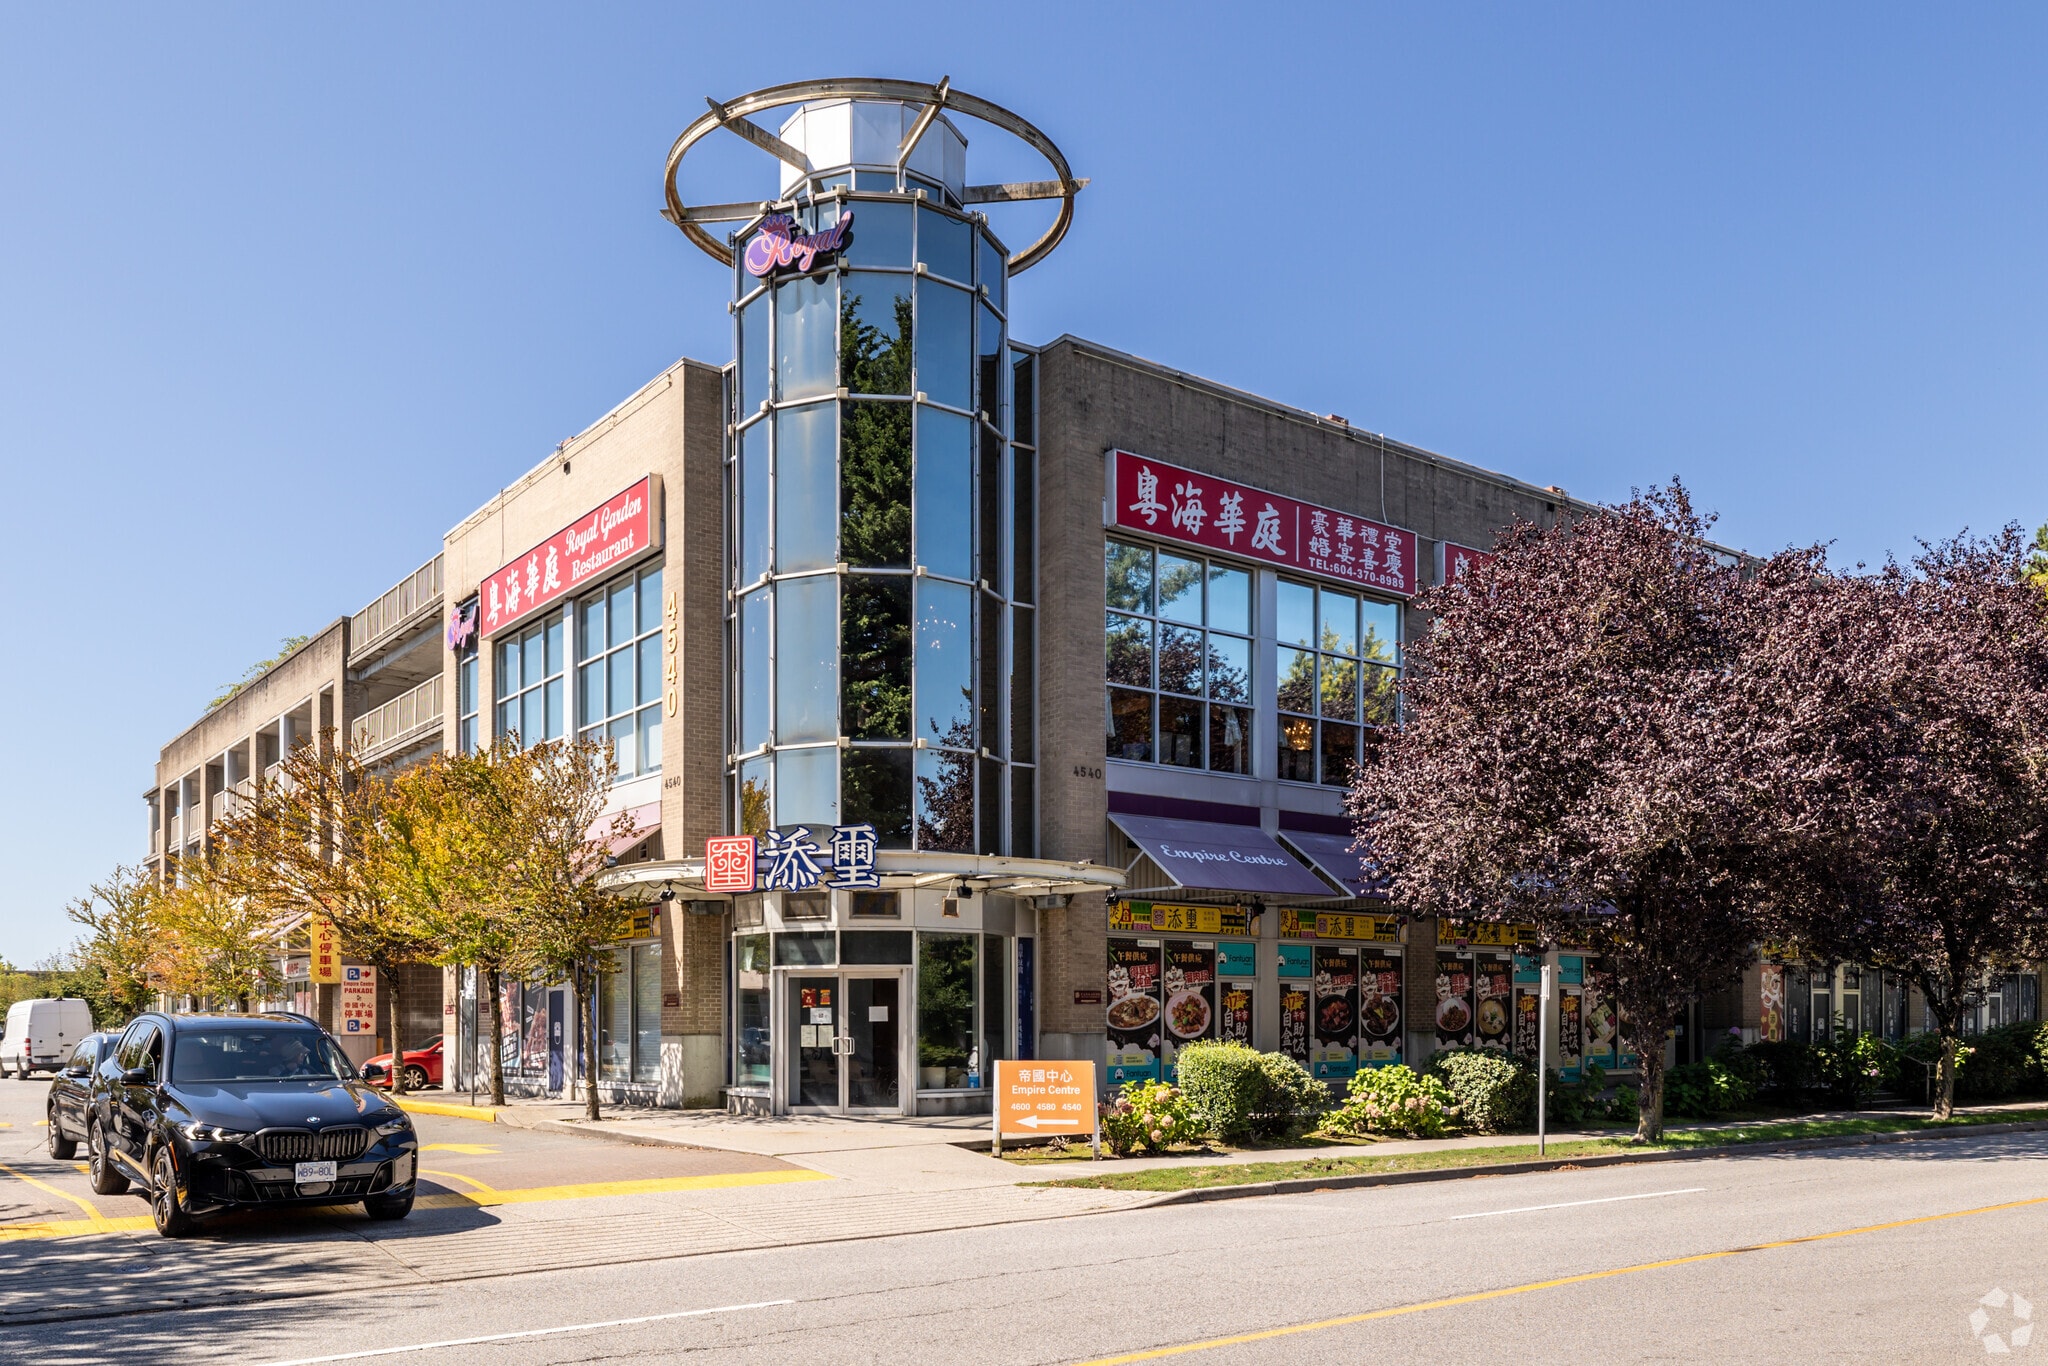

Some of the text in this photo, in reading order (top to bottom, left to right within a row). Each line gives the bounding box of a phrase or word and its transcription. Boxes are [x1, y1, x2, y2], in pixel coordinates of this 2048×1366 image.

[744, 209, 852, 277] Royal
[564, 493, 643, 557] Royal Garden
[1310, 510, 1402, 556] 豪華禮堂
[570, 528, 635, 582] Restaurant
[1308, 536, 1404, 579] 婚宴喜慶
[1308, 556, 1405, 589] TEL:604-370-8989
[666, 591, 678, 718] 4540
[664, 775, 682, 790] 4540
[1073, 765, 1102, 780] 4540
[1160, 844, 1288, 866] Empire Centre
[344, 1009, 374, 1018] 停車場
[1019, 1068, 1073, 1083] 帝國中心
[1011, 1085, 1081, 1097] Empire Centre
[1011, 1102, 1082, 1111] 4600 4580 4540
